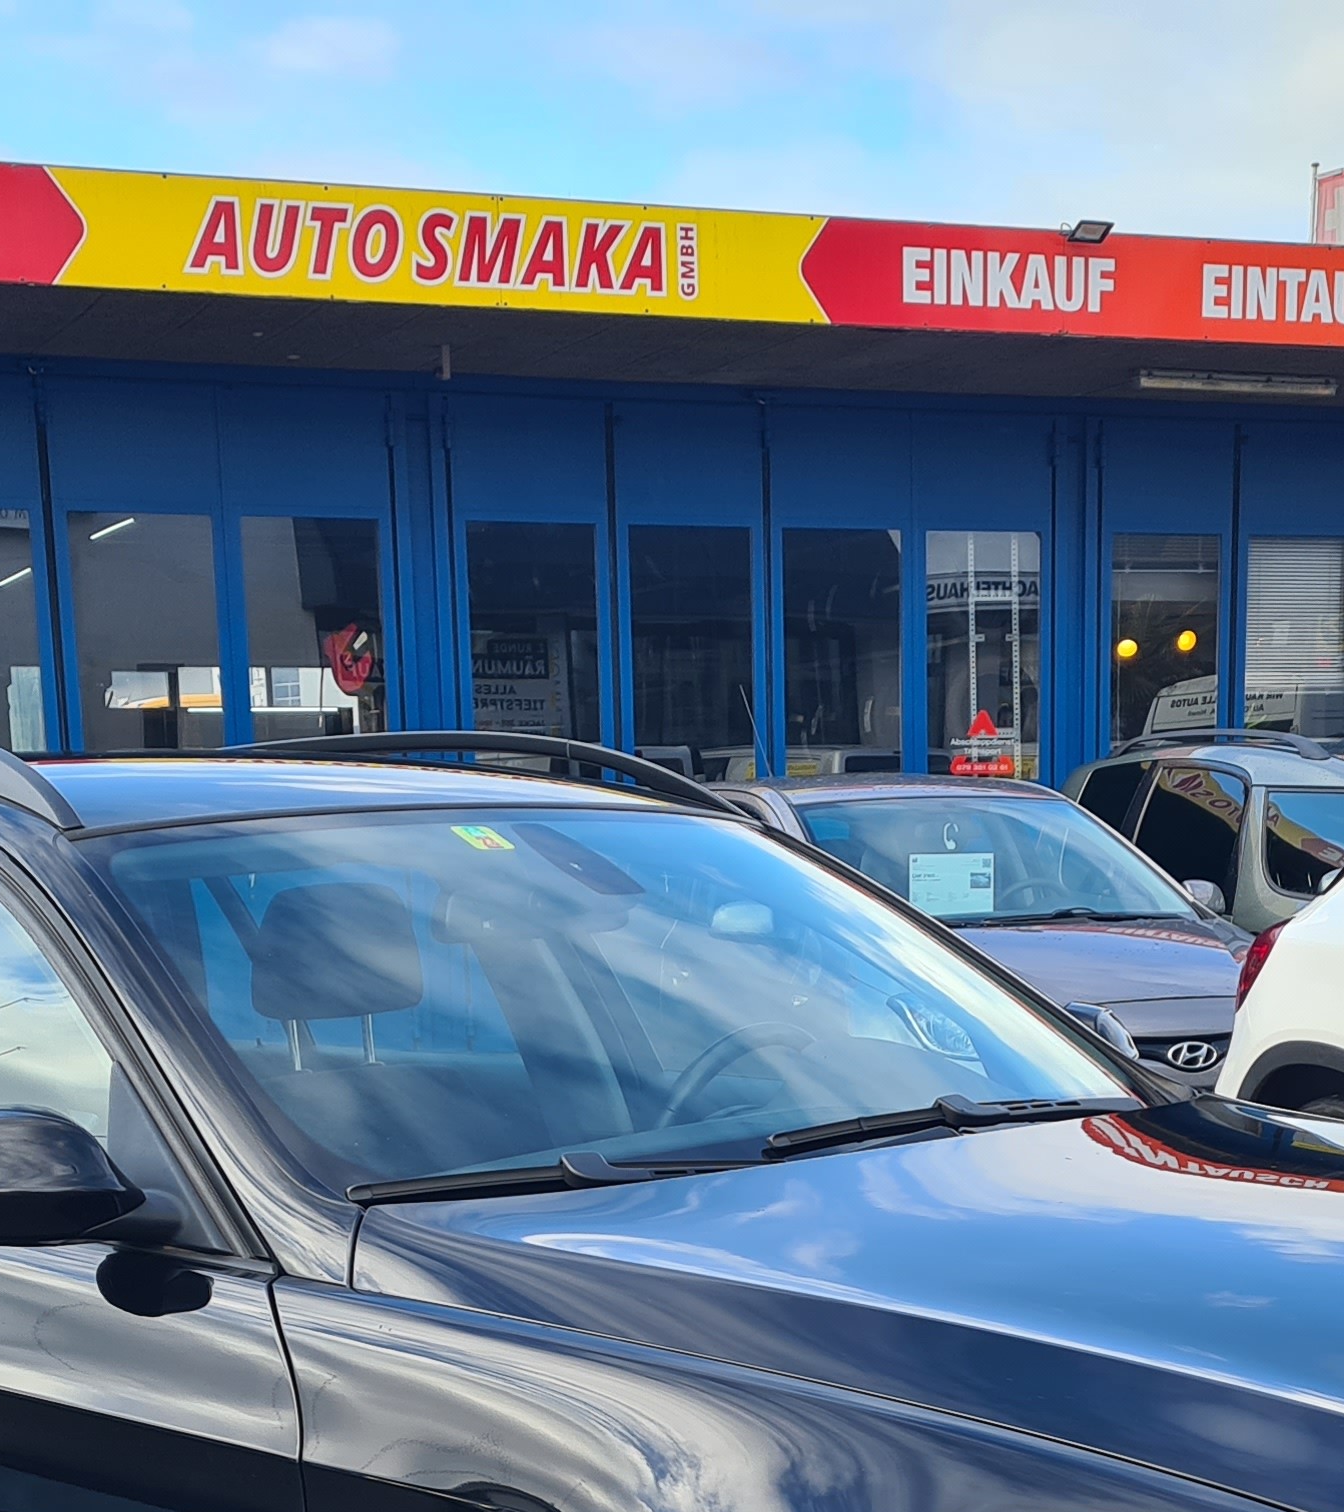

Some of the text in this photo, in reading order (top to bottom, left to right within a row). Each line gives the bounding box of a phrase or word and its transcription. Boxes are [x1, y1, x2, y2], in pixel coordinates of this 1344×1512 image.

[185, 197, 697, 299] AUTO SMAKA GMBH
[901, 245, 1116, 313] EINKAUF
